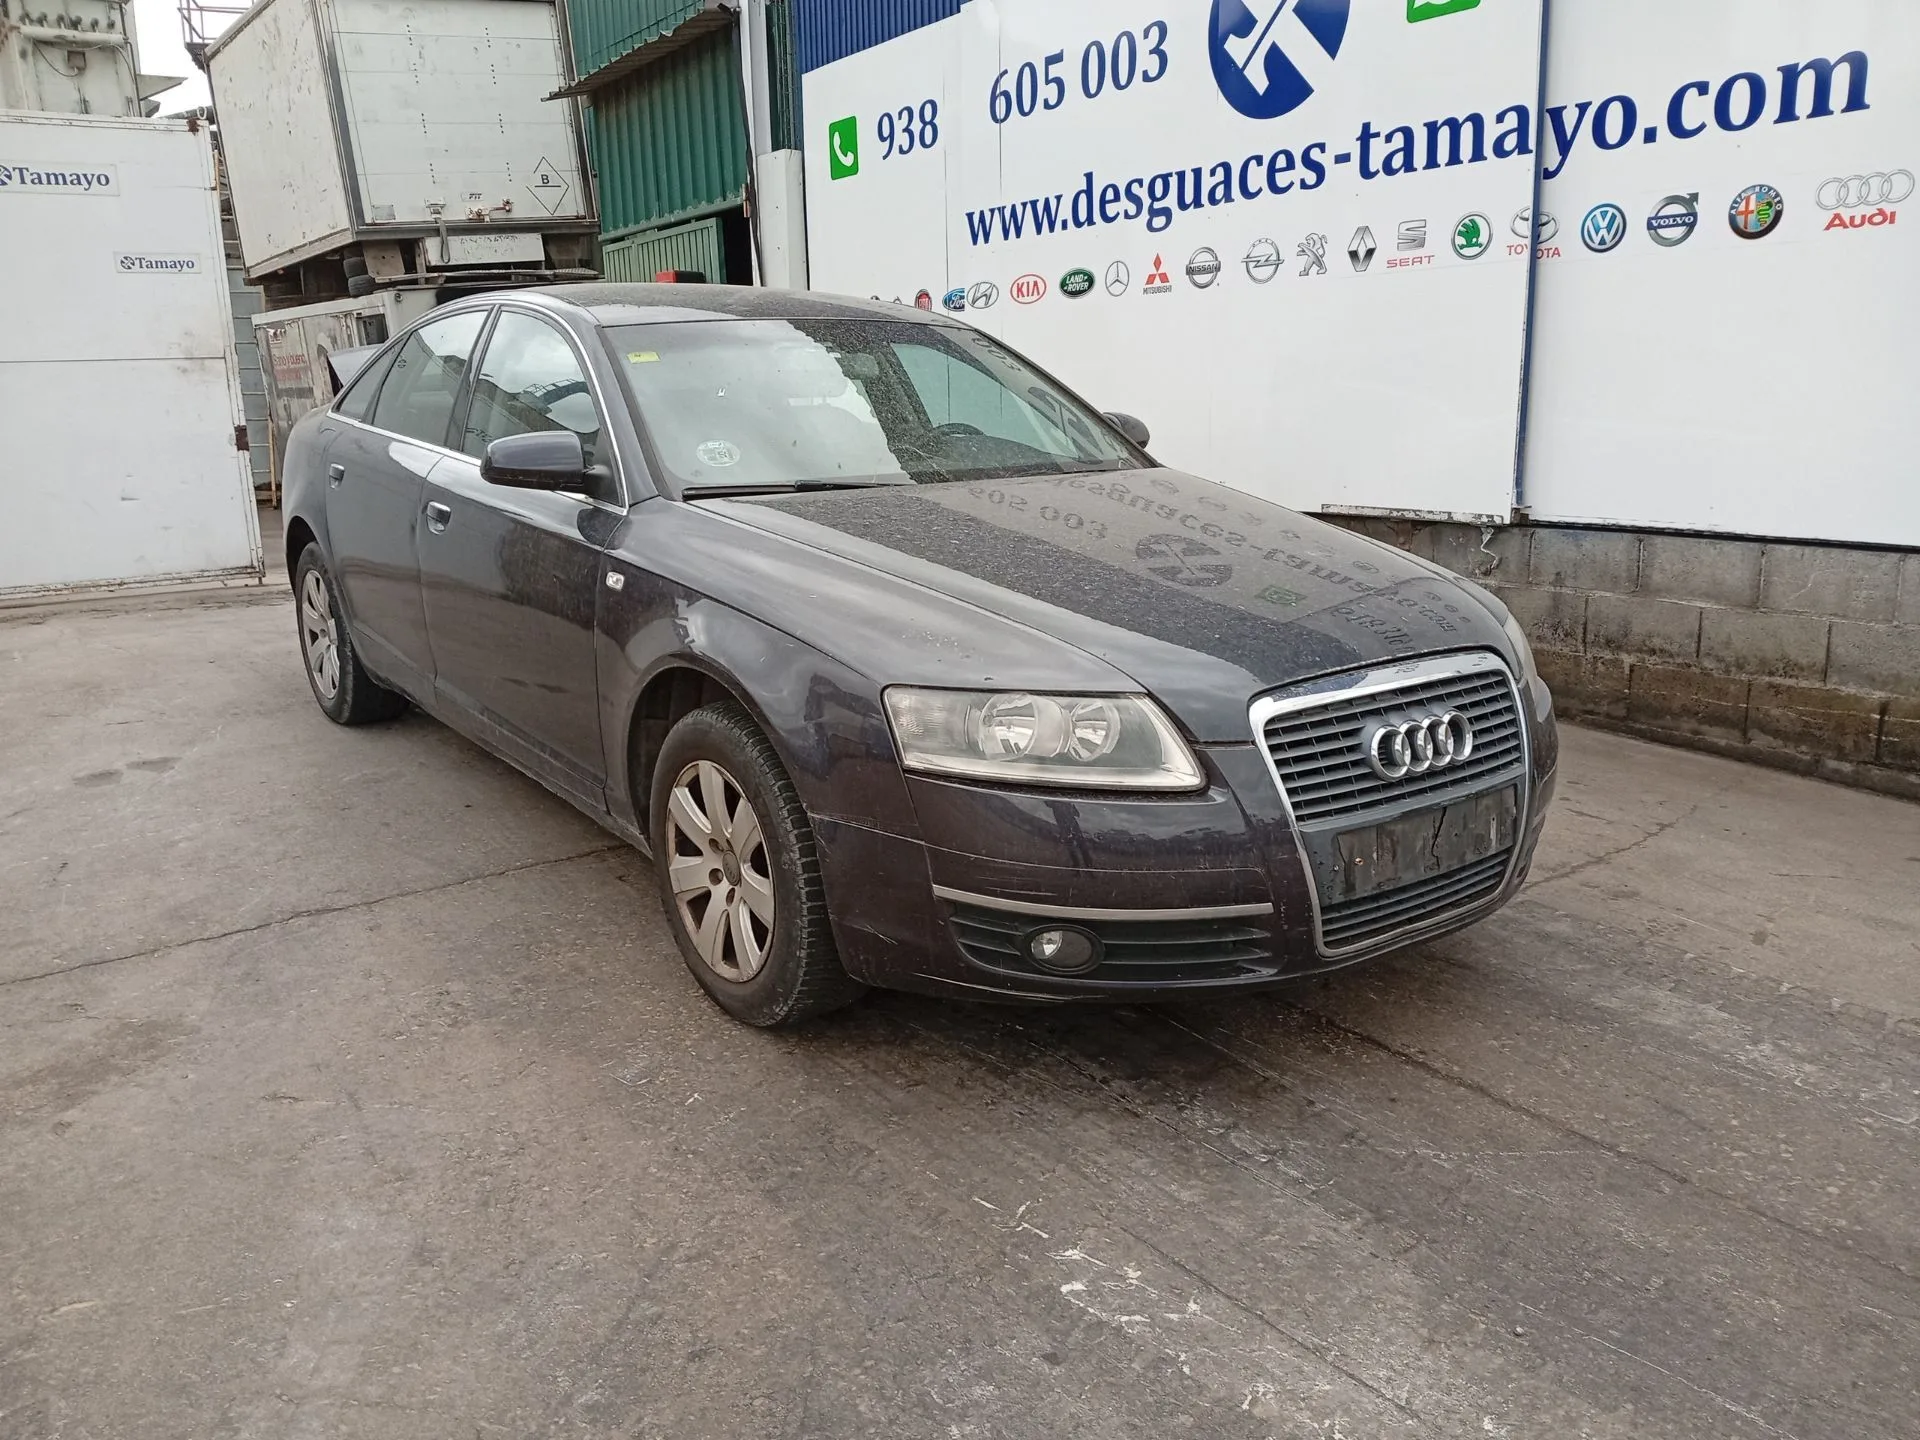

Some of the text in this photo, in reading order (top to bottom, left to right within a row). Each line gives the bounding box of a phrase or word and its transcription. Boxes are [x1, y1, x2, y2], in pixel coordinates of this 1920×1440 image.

[877, 20, 1169, 161] 938 605 003
[965, 50, 1871, 246] www.desguaces-tamayo.com
[13, 167, 110, 191] Tamayo
[541, 174, 550, 185] B
[1650, 215, 1694, 227] VOLVO
[1822, 207, 1897, 232] Audi
[134, 257, 195, 272] Tamayo
[1386, 254, 1436, 269] SEAT
[1188, 264, 1217, 274] NISSAN
[1066, 275, 1083, 284] LAND
[1016, 285, 1040, 299] KIA
[1067, 282, 1089, 292] ROVER
[1142, 286, 1172, 295] MITSUBISHI
